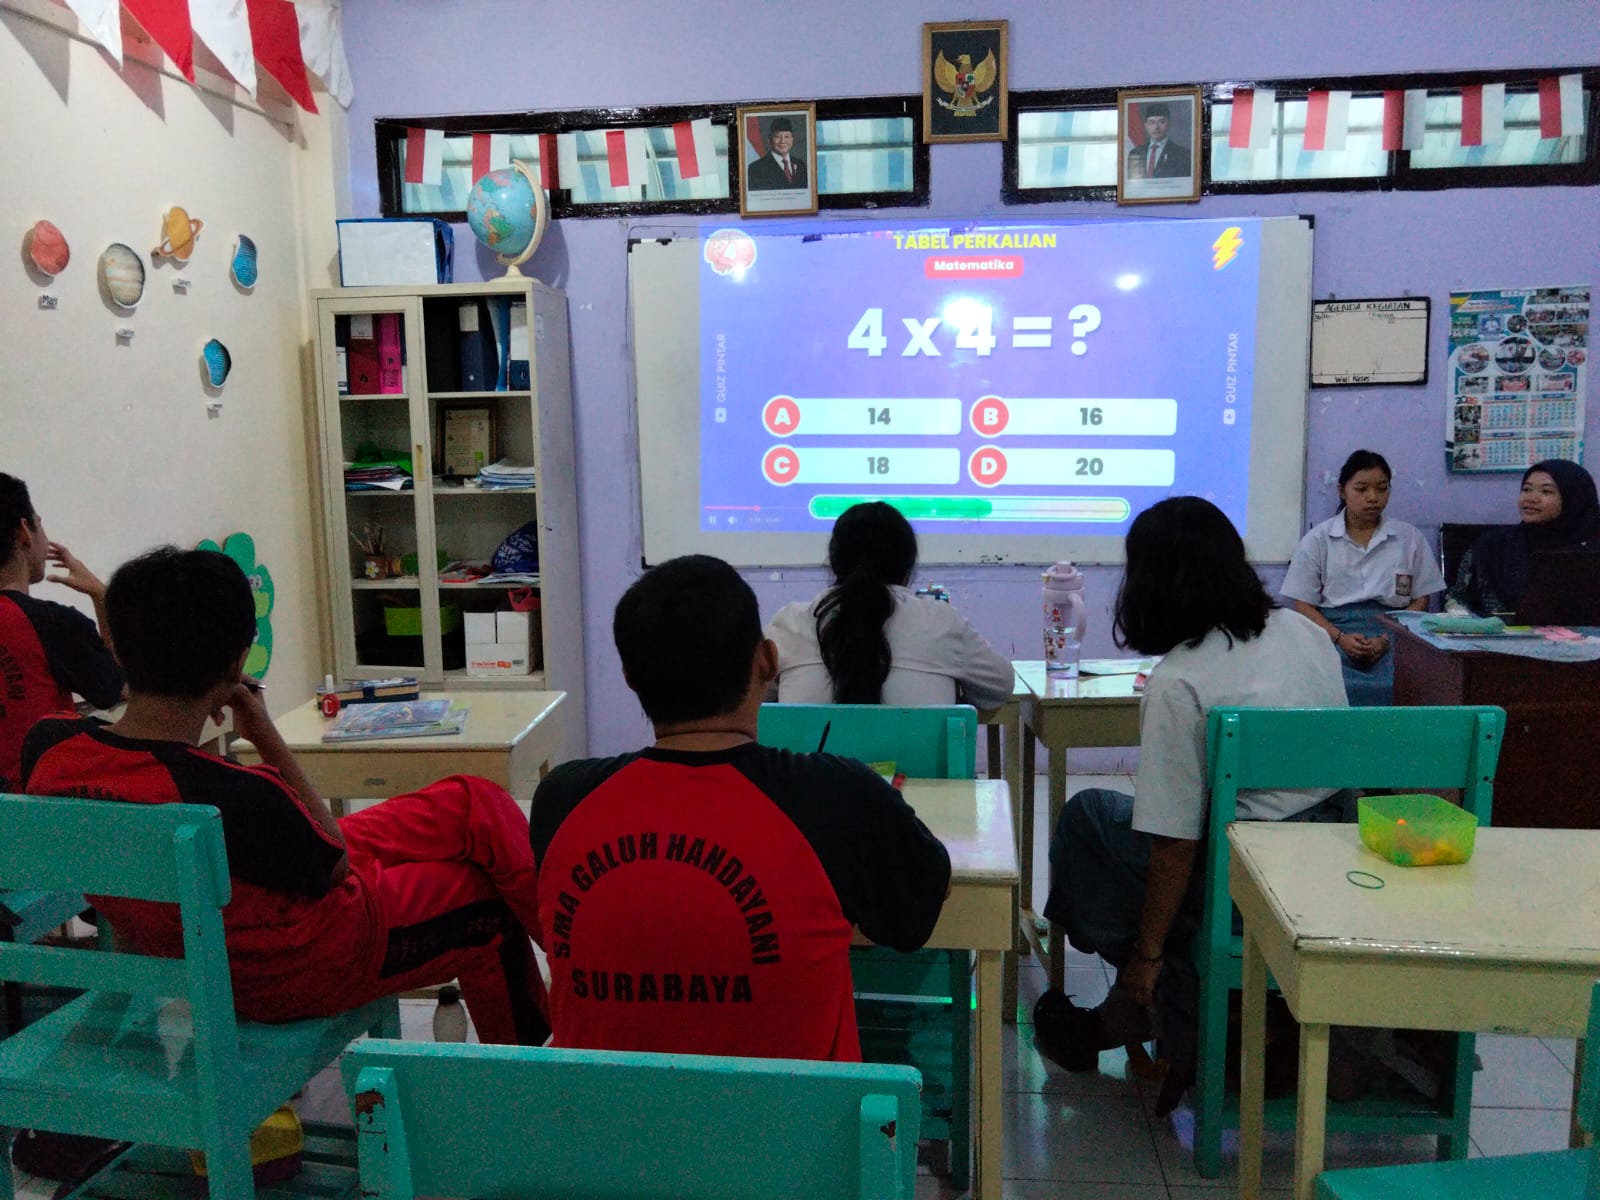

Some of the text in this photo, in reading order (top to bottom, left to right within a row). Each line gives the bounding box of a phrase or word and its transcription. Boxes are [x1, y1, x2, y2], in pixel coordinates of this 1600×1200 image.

[893, 233, 1056, 249] TABEL PERKALIAN
[934, 260, 1014, 271] Matematika
[1325, 302, 1411, 312] AGENDA KEGIATAN
[847, 308, 887, 357] 4
[955, 306, 997, 356] 4
[1012, 316, 1052, 348] =
[1068, 304, 1101, 356] ?
[1225, 332, 1239, 404] QUIZ PINTAR
[774, 407, 891, 425] A 14
[983, 407, 1103, 426] B 16
[774, 456, 890, 475] C 18
[980, 457, 1104, 476] D 20
[553, 890, 580, 960] SMA
[571, 832, 658, 892] GALUH
[665, 833, 781, 965] HANDAYANI
[571, 968, 753, 1003] SURABAYA
